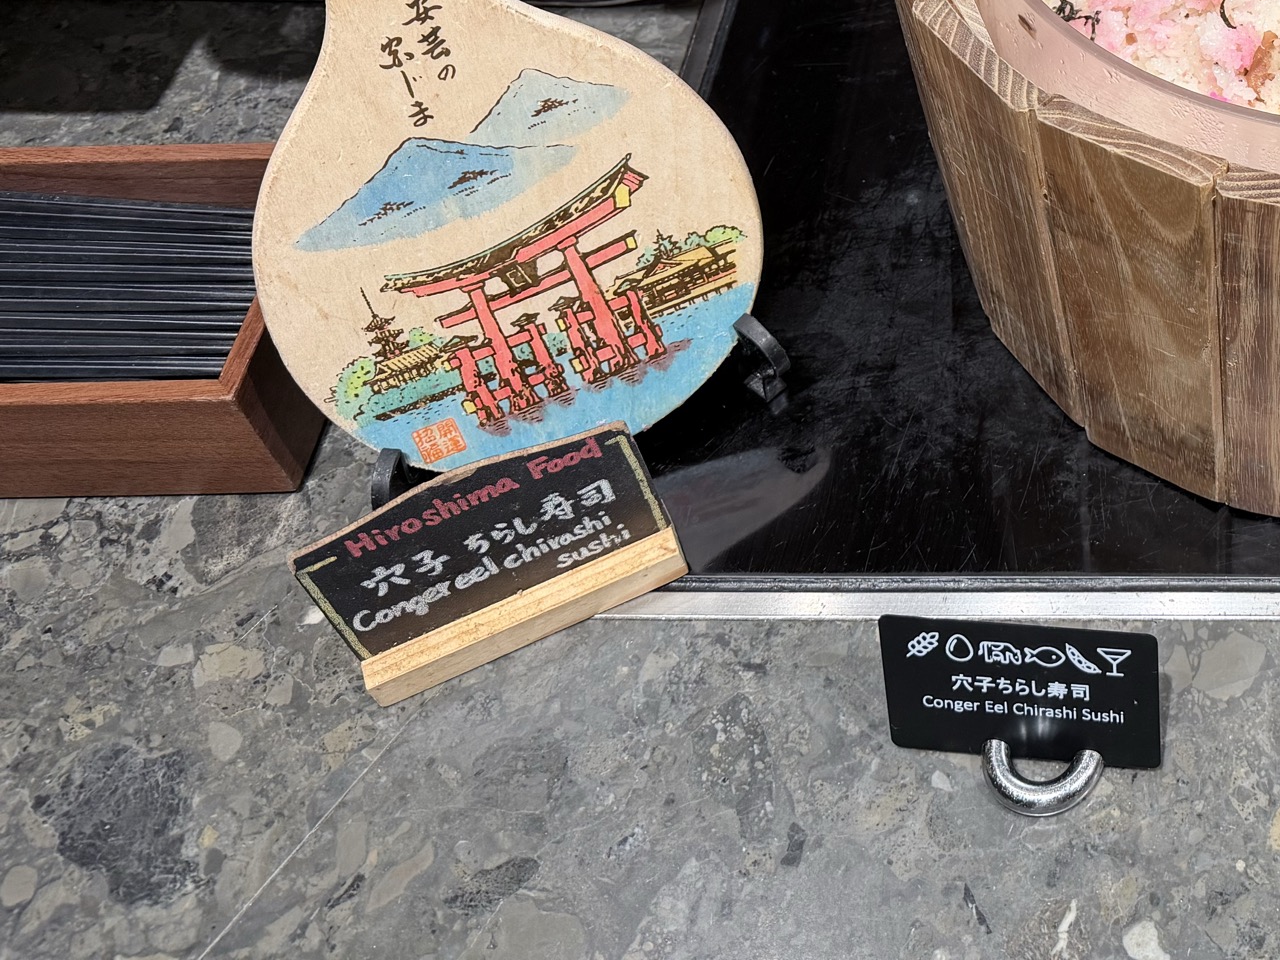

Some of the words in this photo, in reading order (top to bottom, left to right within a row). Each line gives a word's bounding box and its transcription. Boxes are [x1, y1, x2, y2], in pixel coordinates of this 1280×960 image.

[344, 477, 520, 558] Hiroshima
[526, 437, 603, 480] Food
[556, 524, 632, 569] sushi
[352, 581, 452, 632] Conger
[454, 555, 499, 590] eel
[503, 511, 612, 569] chirashi
[922, 695, 981, 713] Conger
[985, 700, 1008, 714] Eel
[1012, 702, 1077, 720] Chirashi
[1082, 708, 1125, 724] Sushi
[951, 673, 1090, 701] 穴子ちらし寿司
